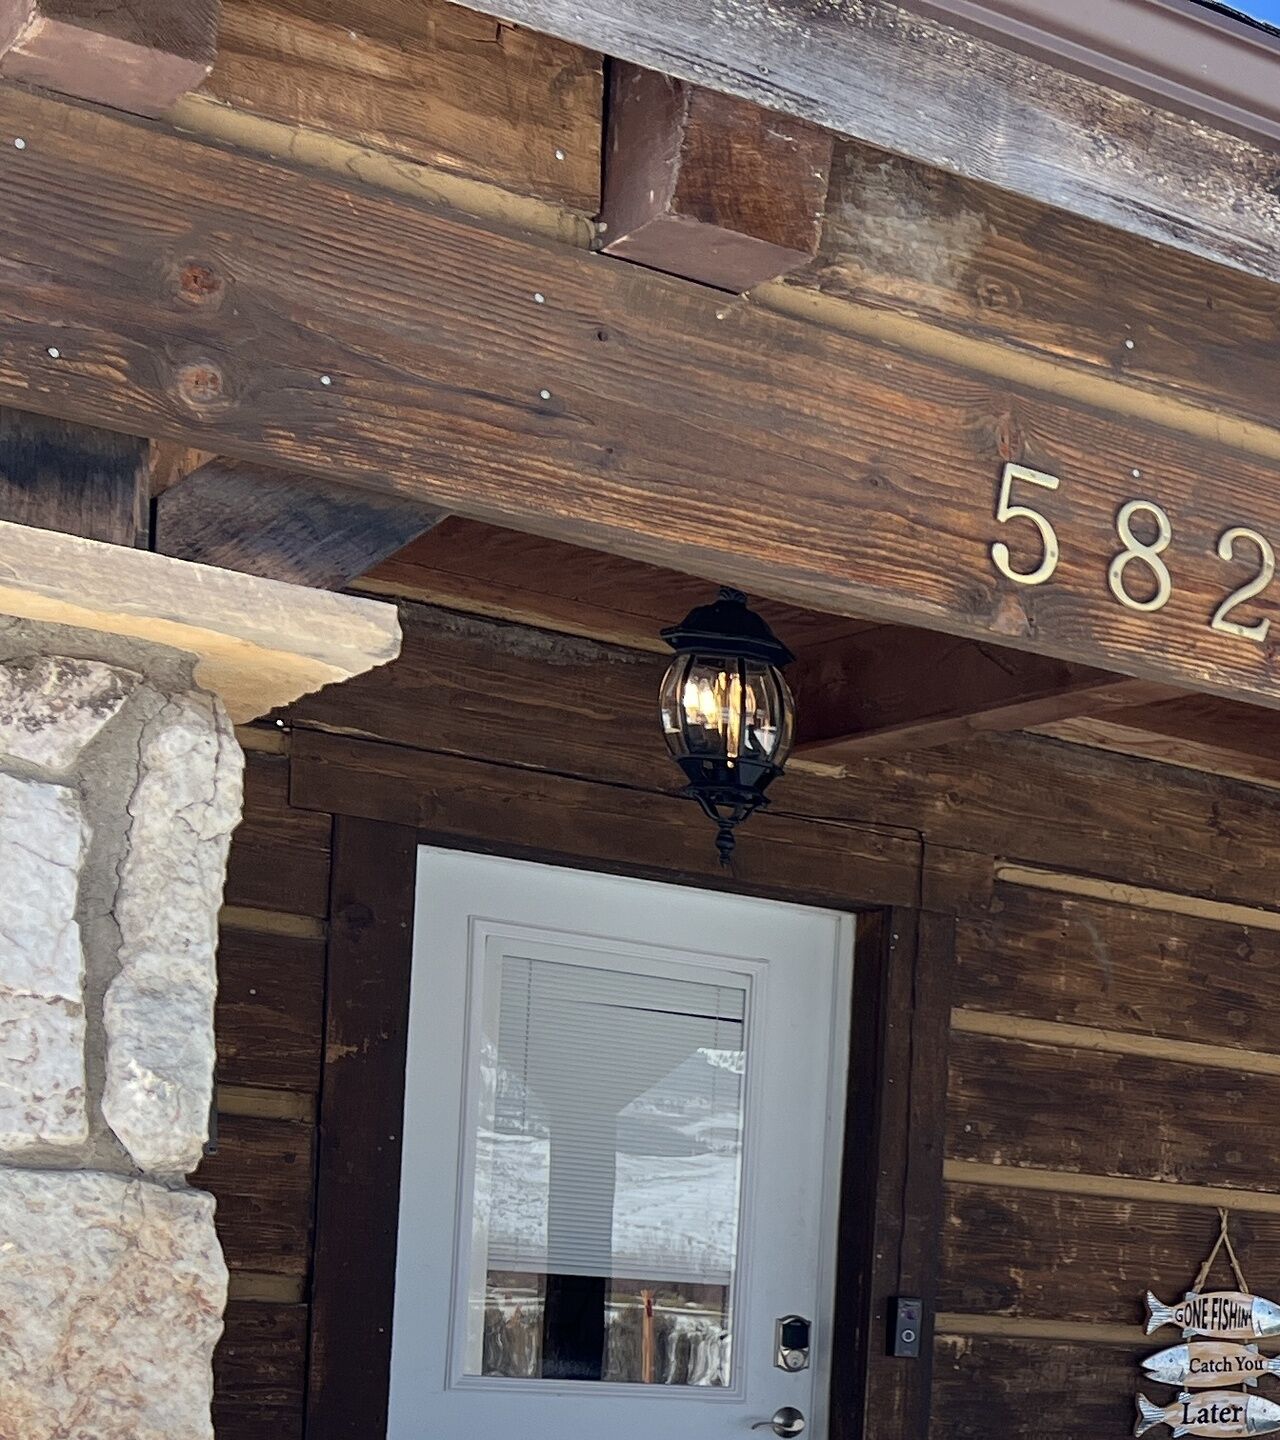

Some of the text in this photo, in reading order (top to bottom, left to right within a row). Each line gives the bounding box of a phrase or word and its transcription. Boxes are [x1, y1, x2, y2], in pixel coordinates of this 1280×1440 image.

[1175, 1298, 1208, 1329] GONE
[1189, 1356, 1264, 1374] Catch You
[1181, 1402, 1244, 1425] Later
